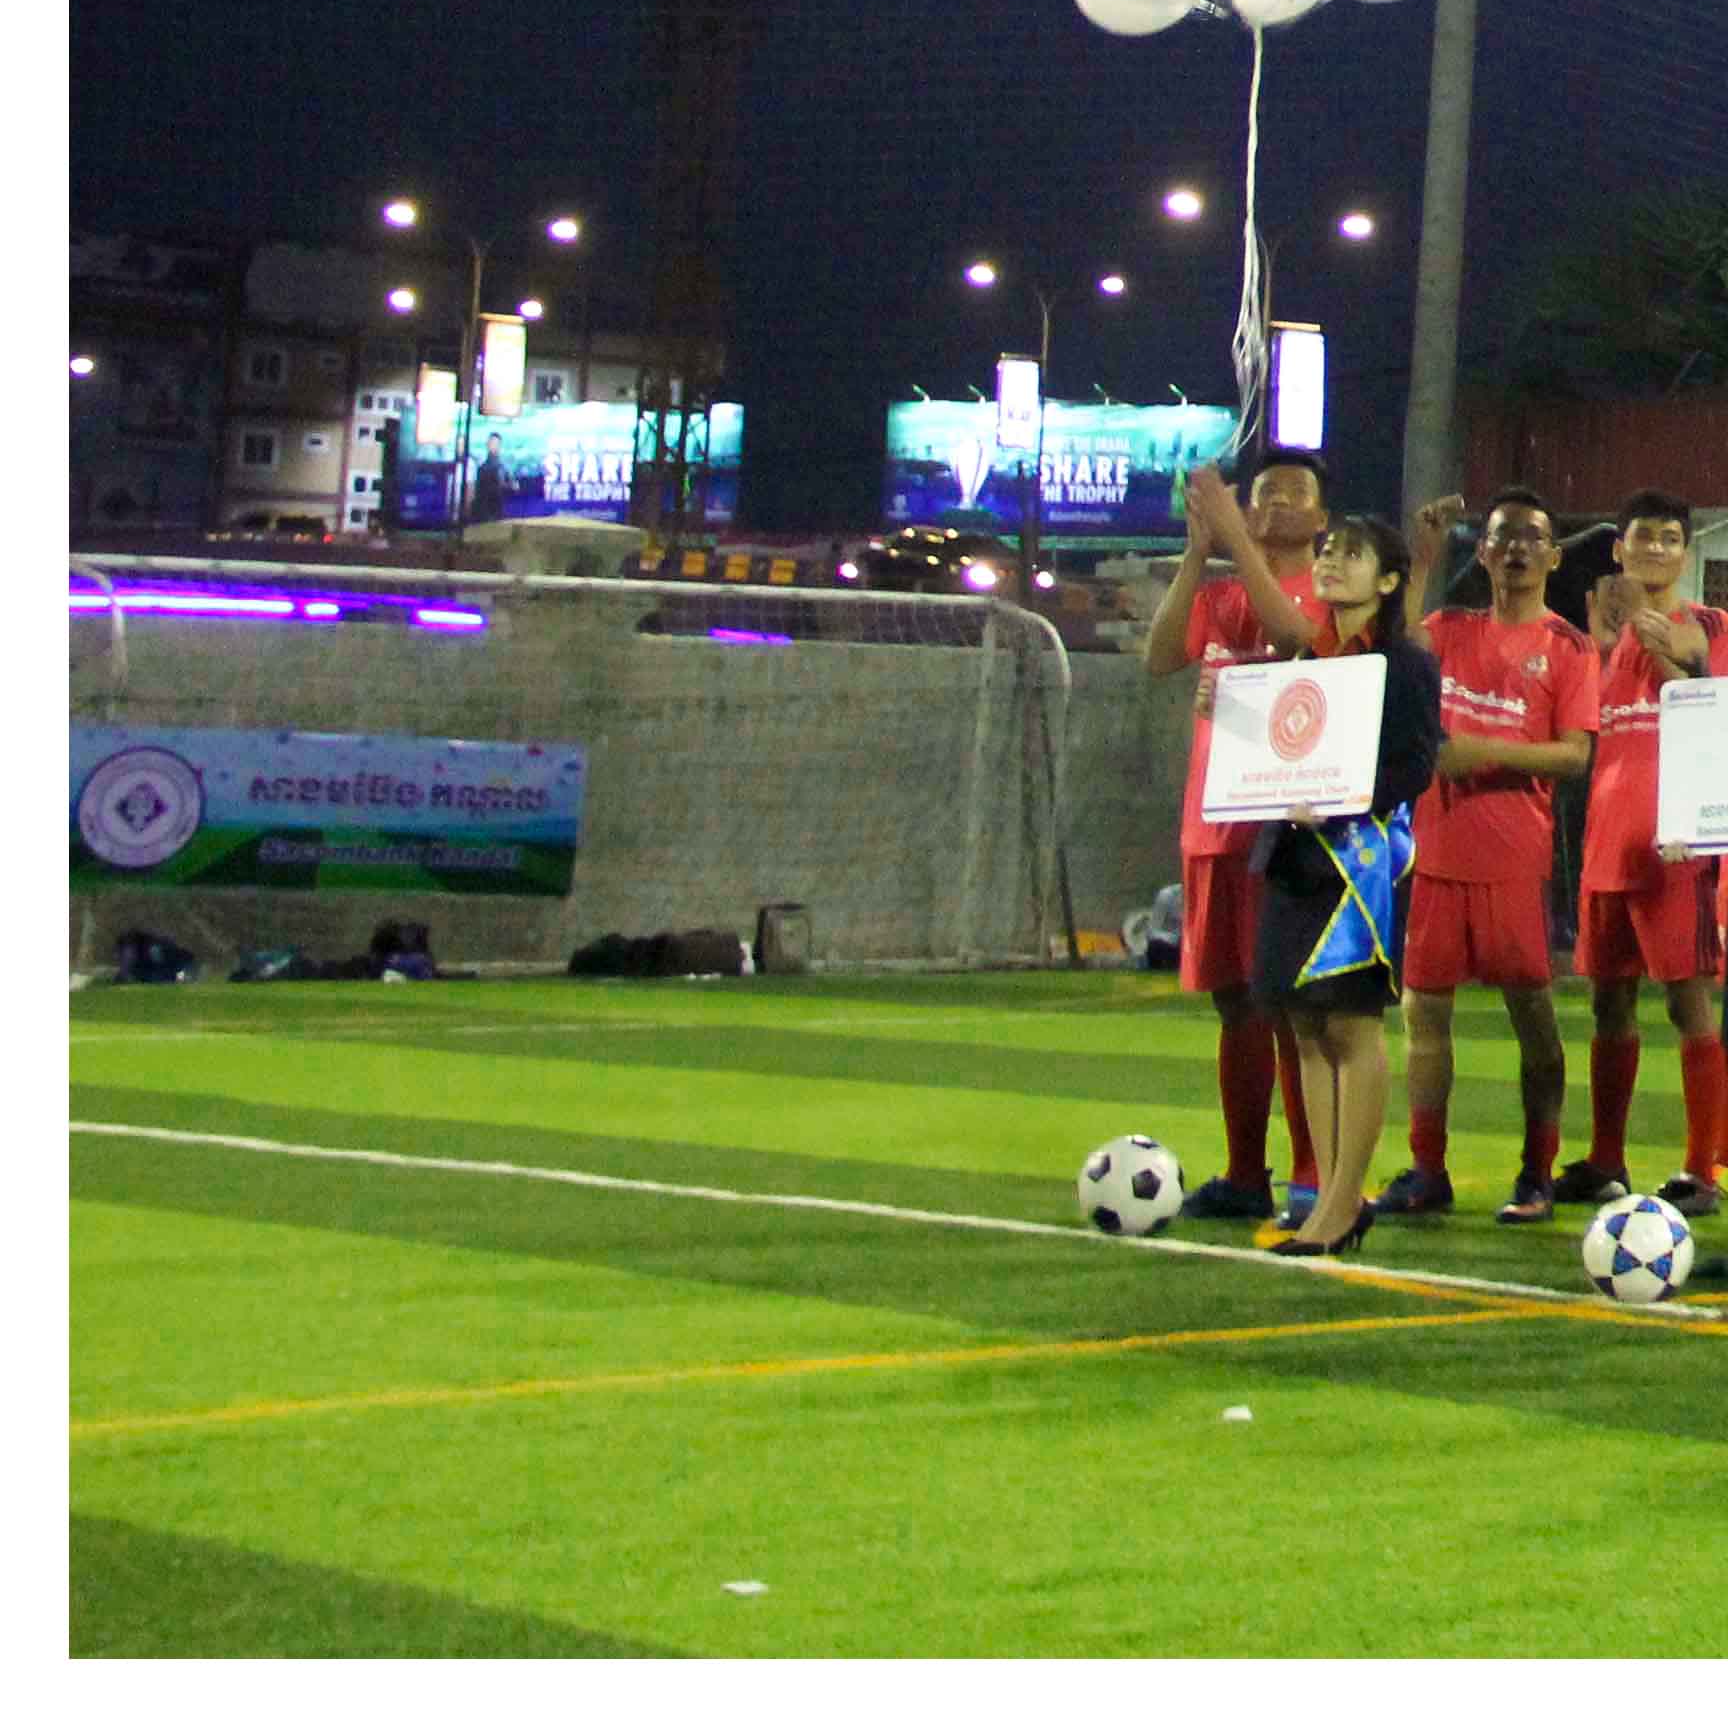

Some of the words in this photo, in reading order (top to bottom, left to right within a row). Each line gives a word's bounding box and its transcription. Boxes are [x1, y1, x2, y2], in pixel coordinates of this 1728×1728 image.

[543, 452, 634, 482] SHARE
[1040, 454, 1129, 484] SHARE
[1067, 483, 1128, 505] TROPHY
